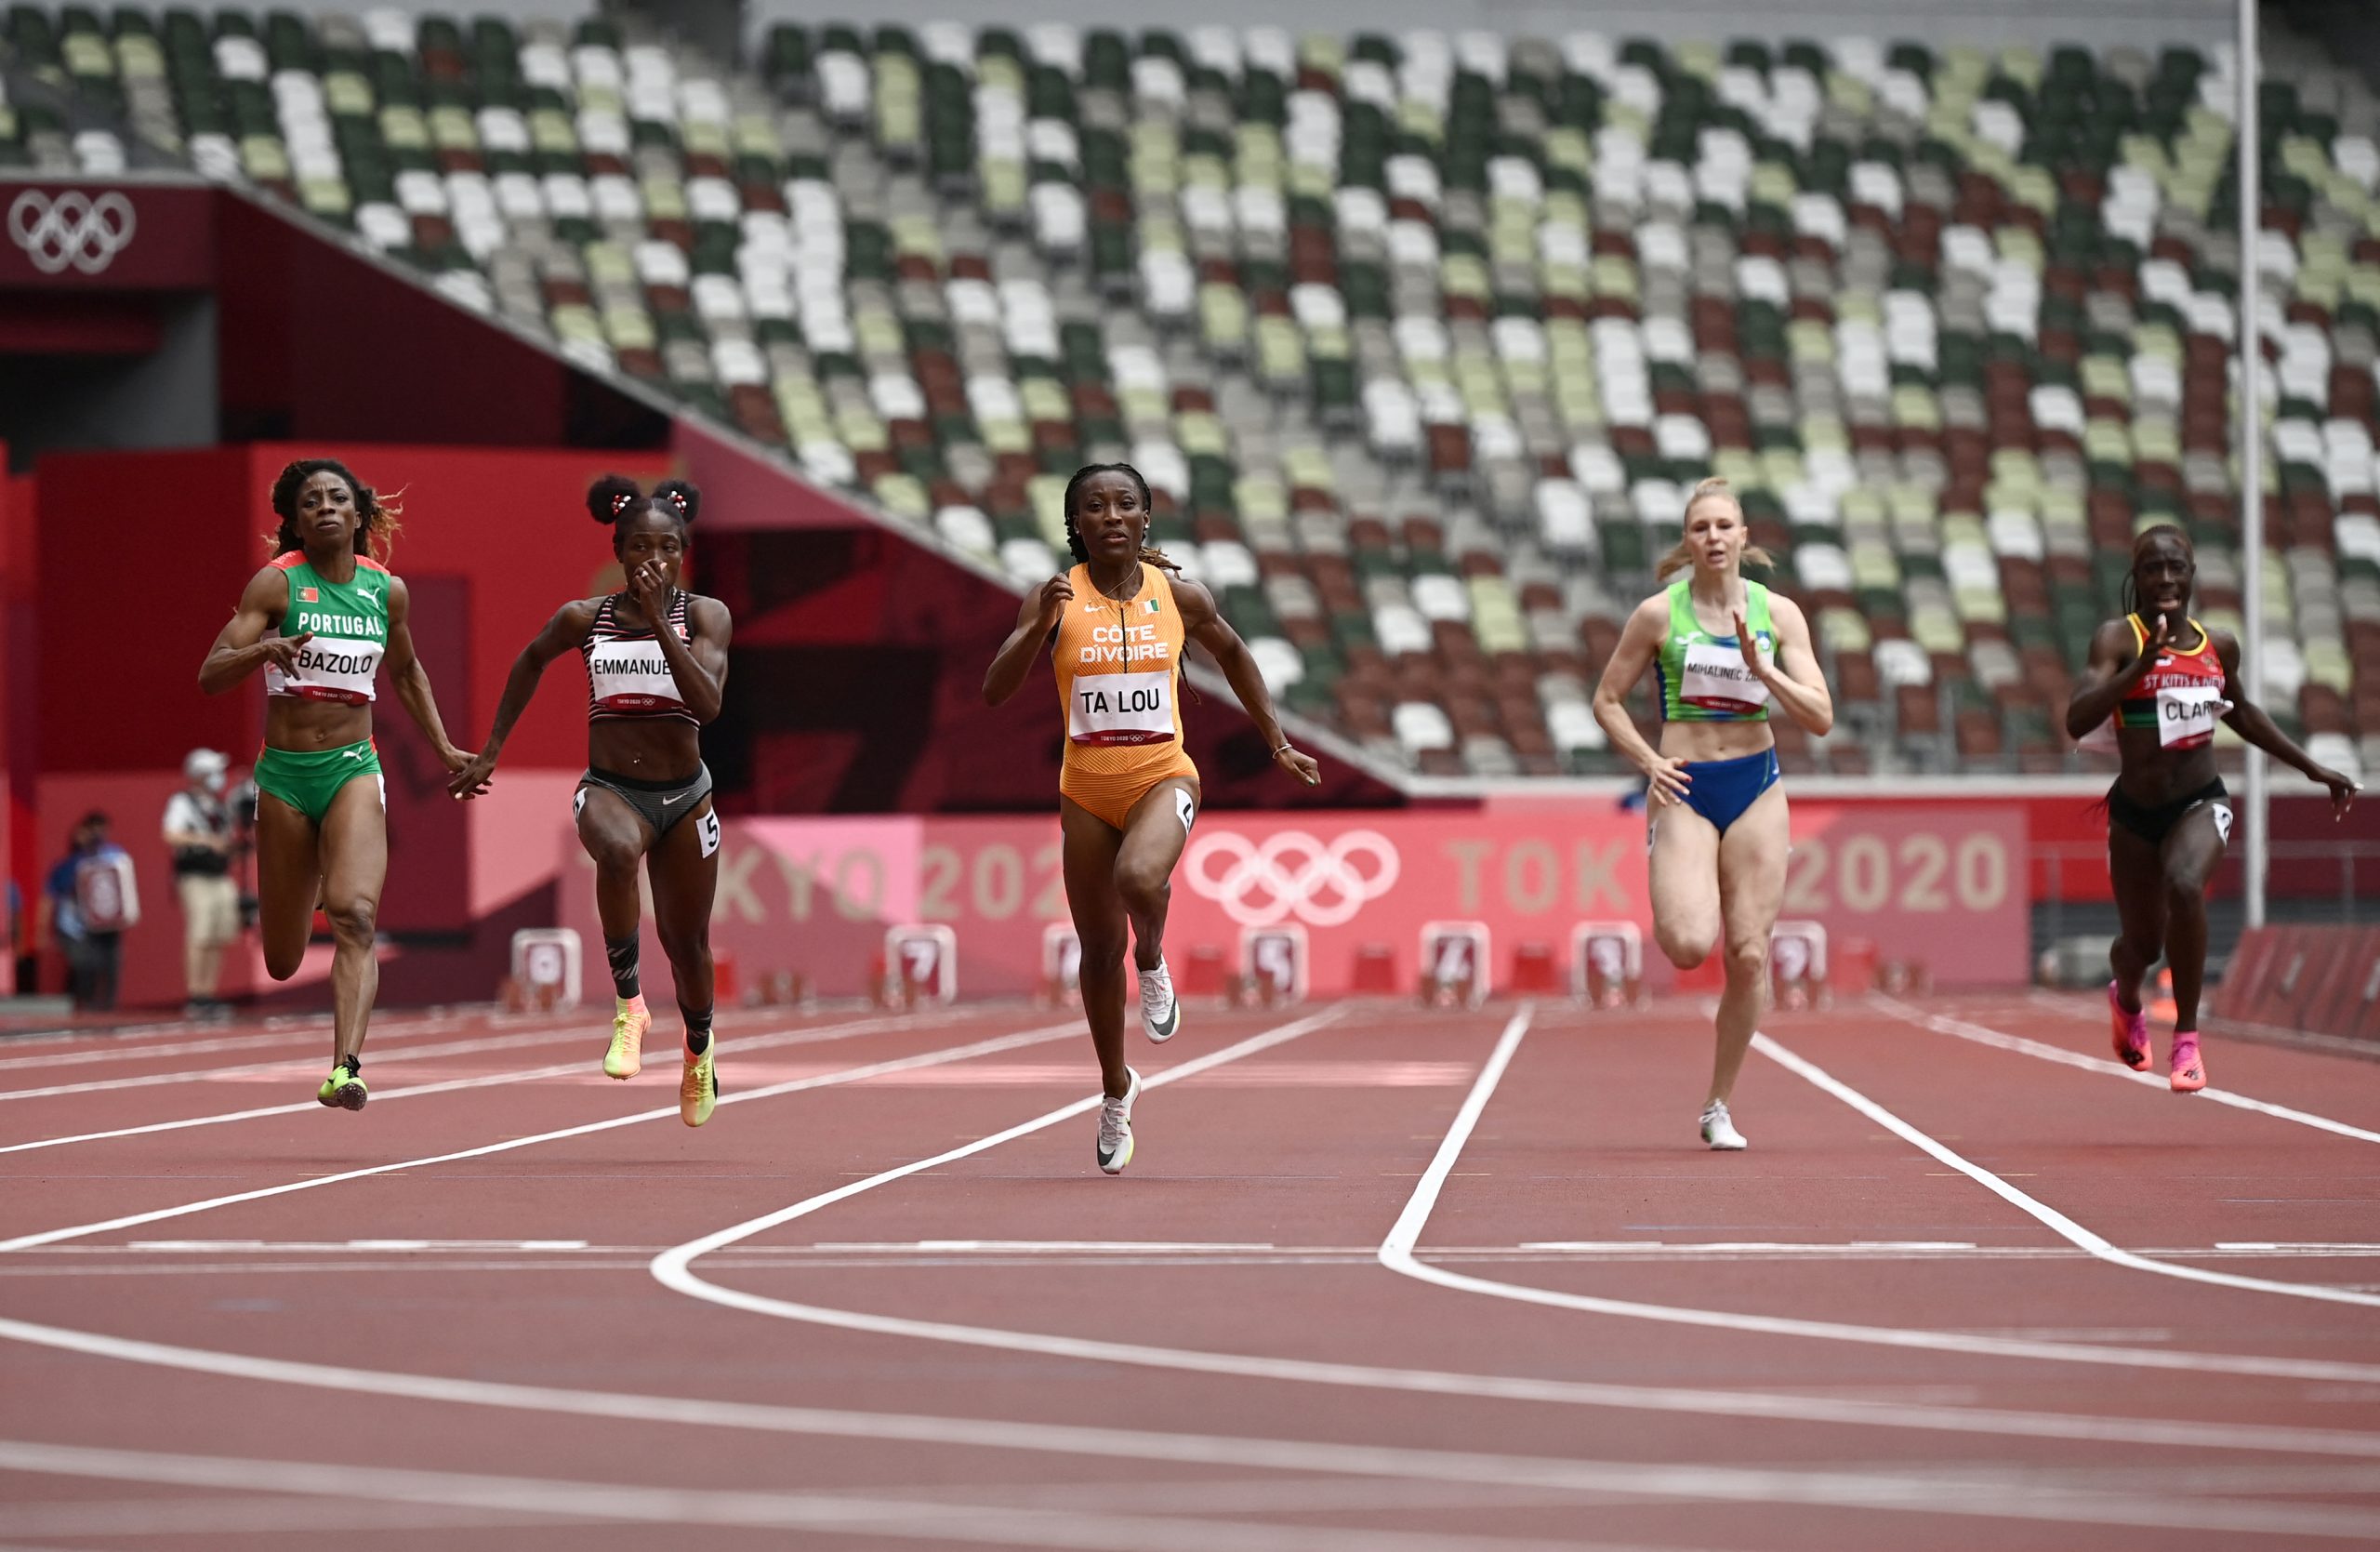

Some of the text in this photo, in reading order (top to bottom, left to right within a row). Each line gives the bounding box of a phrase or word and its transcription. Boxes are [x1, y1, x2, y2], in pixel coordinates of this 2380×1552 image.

[298, 611, 383, 637] PORTUGAL
[1092, 624, 1157, 643] CÔTE
[298, 649, 373, 675] BAZOLO
[594, 658, 671, 675] EMMANUE
[1687, 662, 1759, 683] MIHALINEC ZI
[2144, 673, 2159, 690] ST
[2162, 673, 2189, 687] KITTS
[1080, 688, 1160, 714] TA LOU
[2165, 700, 2215, 721] CLAR
[707, 814, 718, 847] 5
[916, 844, 1070, 920] 202
[1446, 830, 2009, 915] TOK 2020
[902, 939, 937, 982] 7
